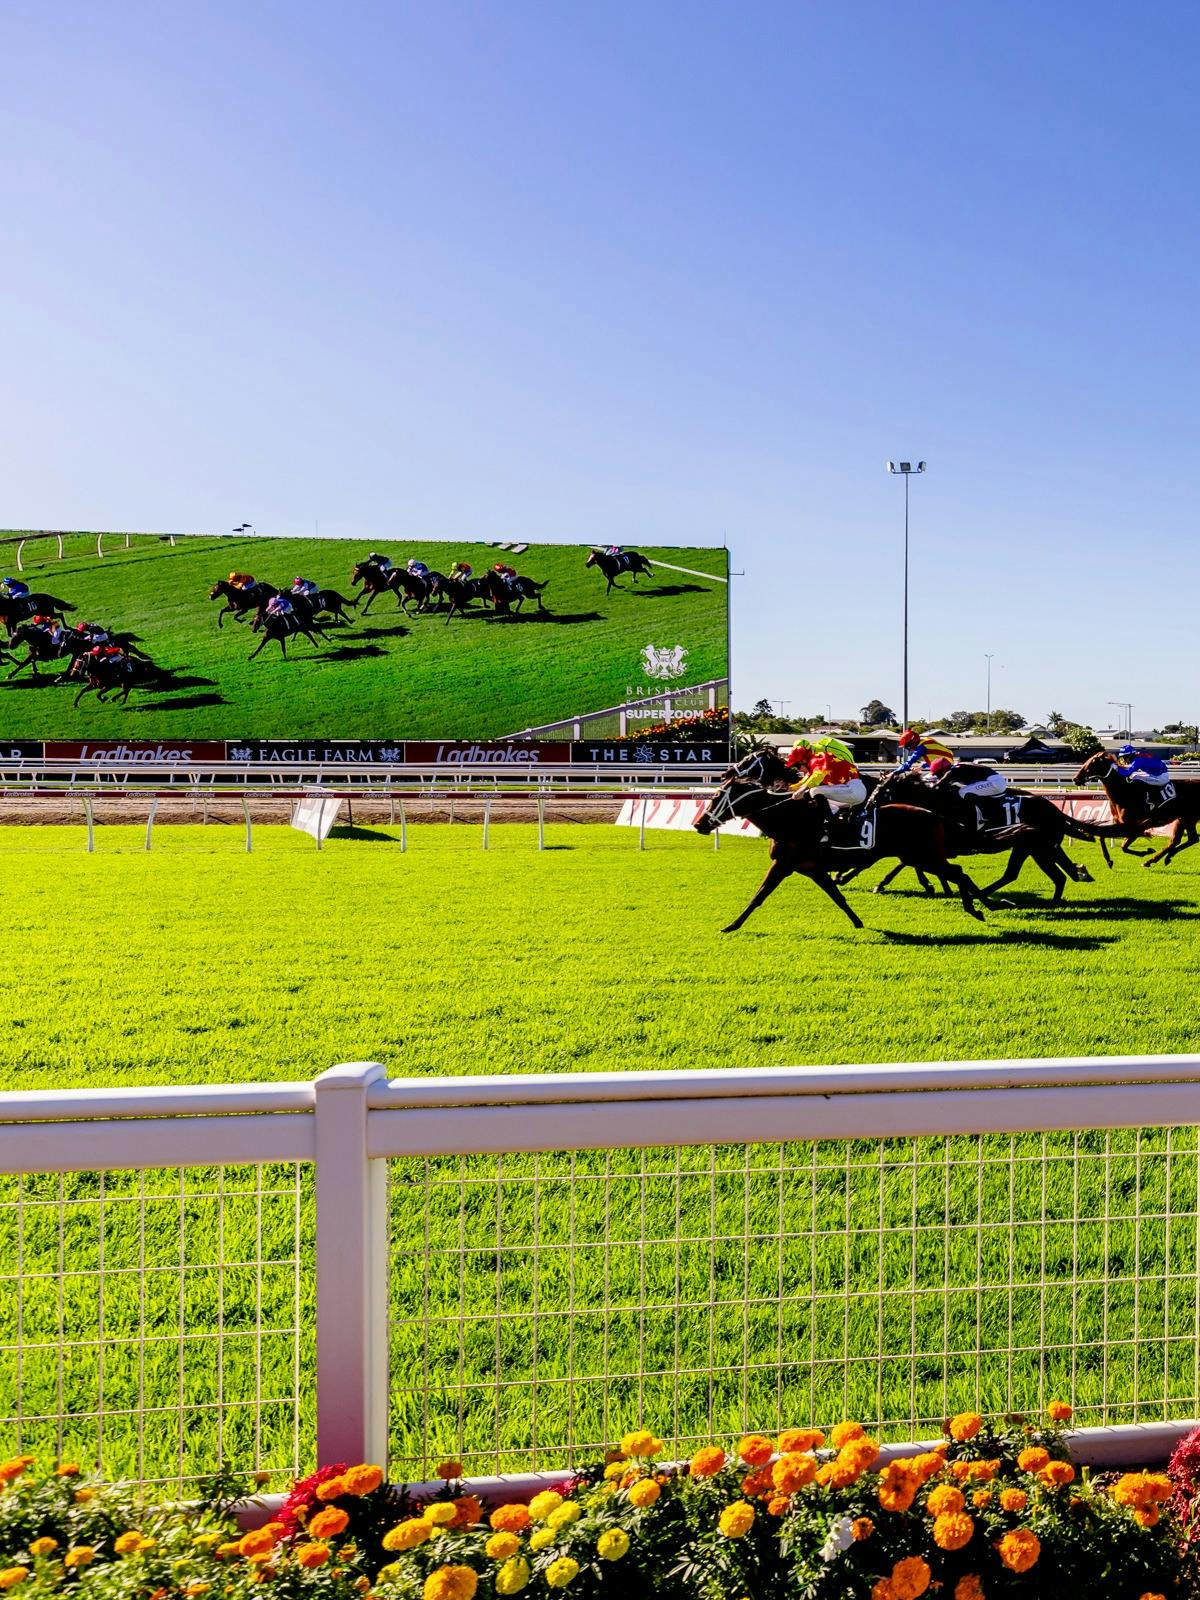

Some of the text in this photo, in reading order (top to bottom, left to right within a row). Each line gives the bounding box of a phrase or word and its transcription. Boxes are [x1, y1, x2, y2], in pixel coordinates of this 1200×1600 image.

[626, 686, 704, 696] BRISBANE
[675, 699, 704, 707] CLUB
[626, 709, 704, 720] SUPERZOOM
[80, 745, 193, 763] Ladbrokes
[259, 749, 375, 762] EAGLE FARM
[436, 745, 540, 763] Ladbrokes
[590, 749, 712, 761] THE STAR
[1160, 783, 1176, 801] 10
[1003, 802, 1021, 826] 11
[860, 820, 873, 849] 9
